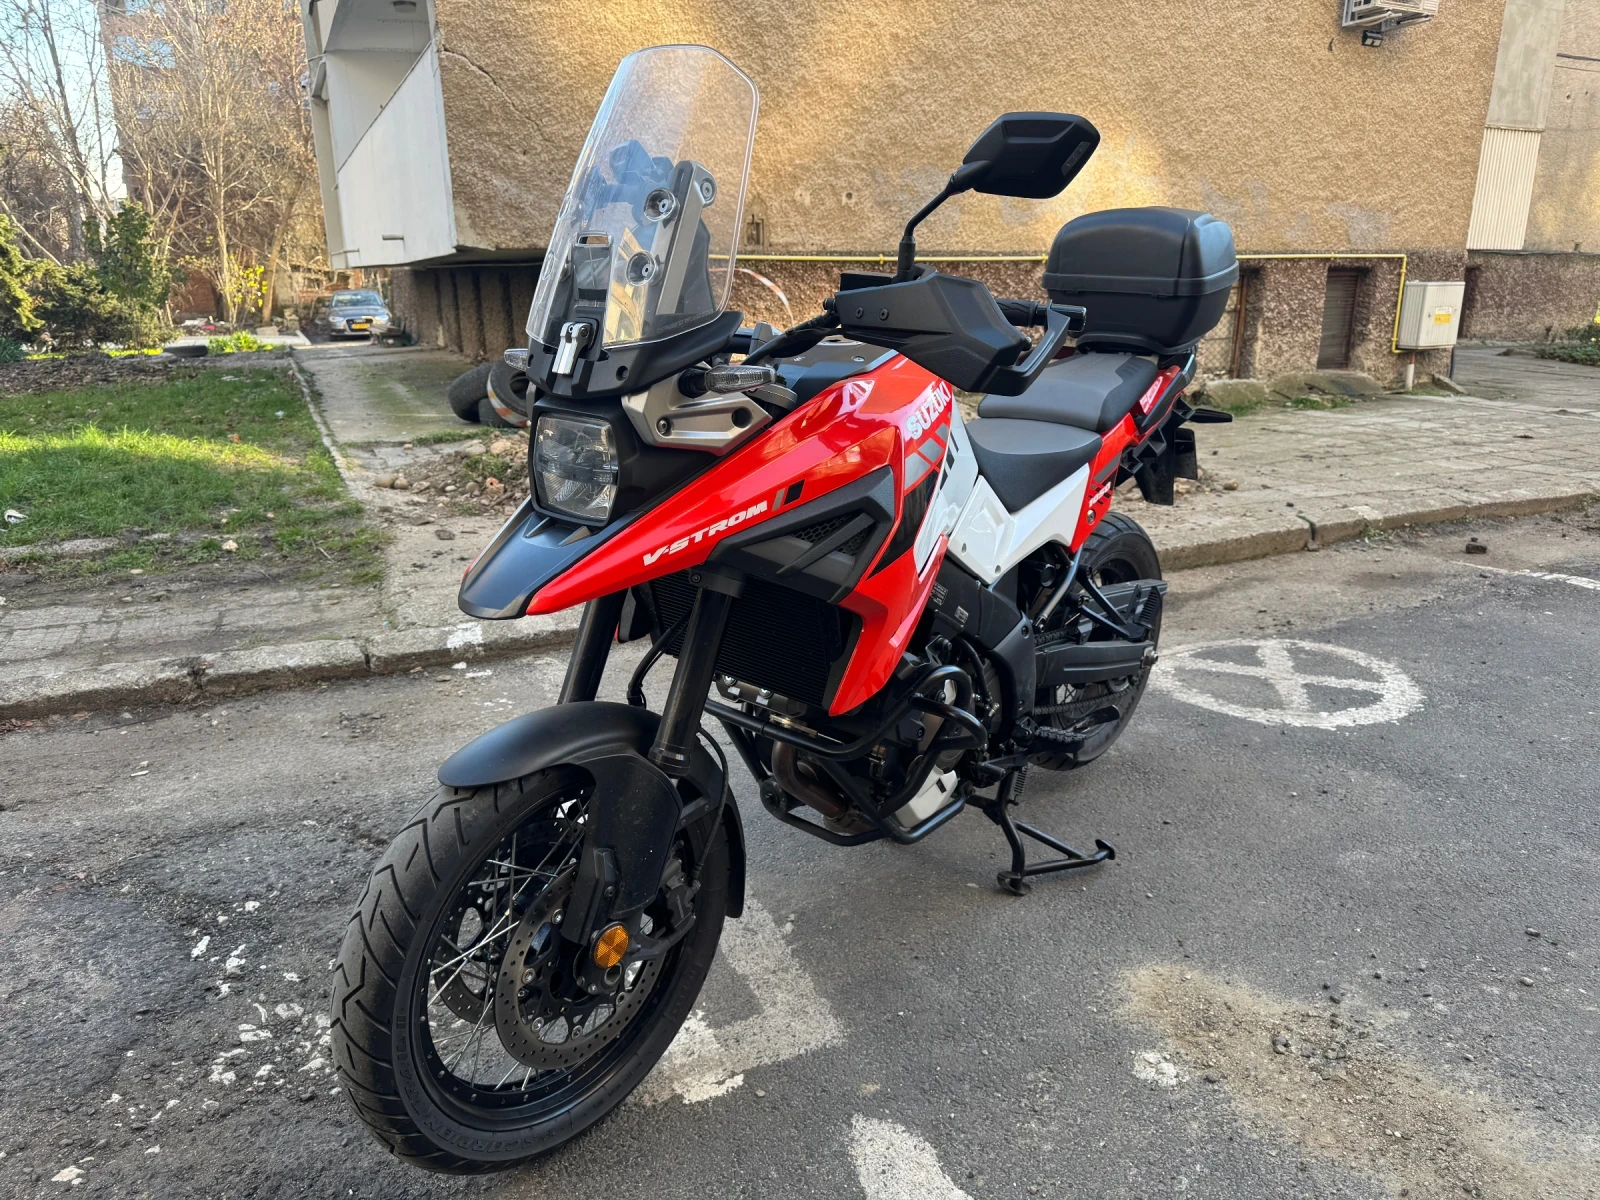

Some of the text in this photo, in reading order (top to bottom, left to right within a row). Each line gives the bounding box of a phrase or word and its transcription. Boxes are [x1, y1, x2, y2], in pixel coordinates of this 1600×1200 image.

[906, 381, 951, 439] SUZUKI
[643, 500, 768, 566] V-STROM
[424, 1116, 535, 1153] SCORPION
